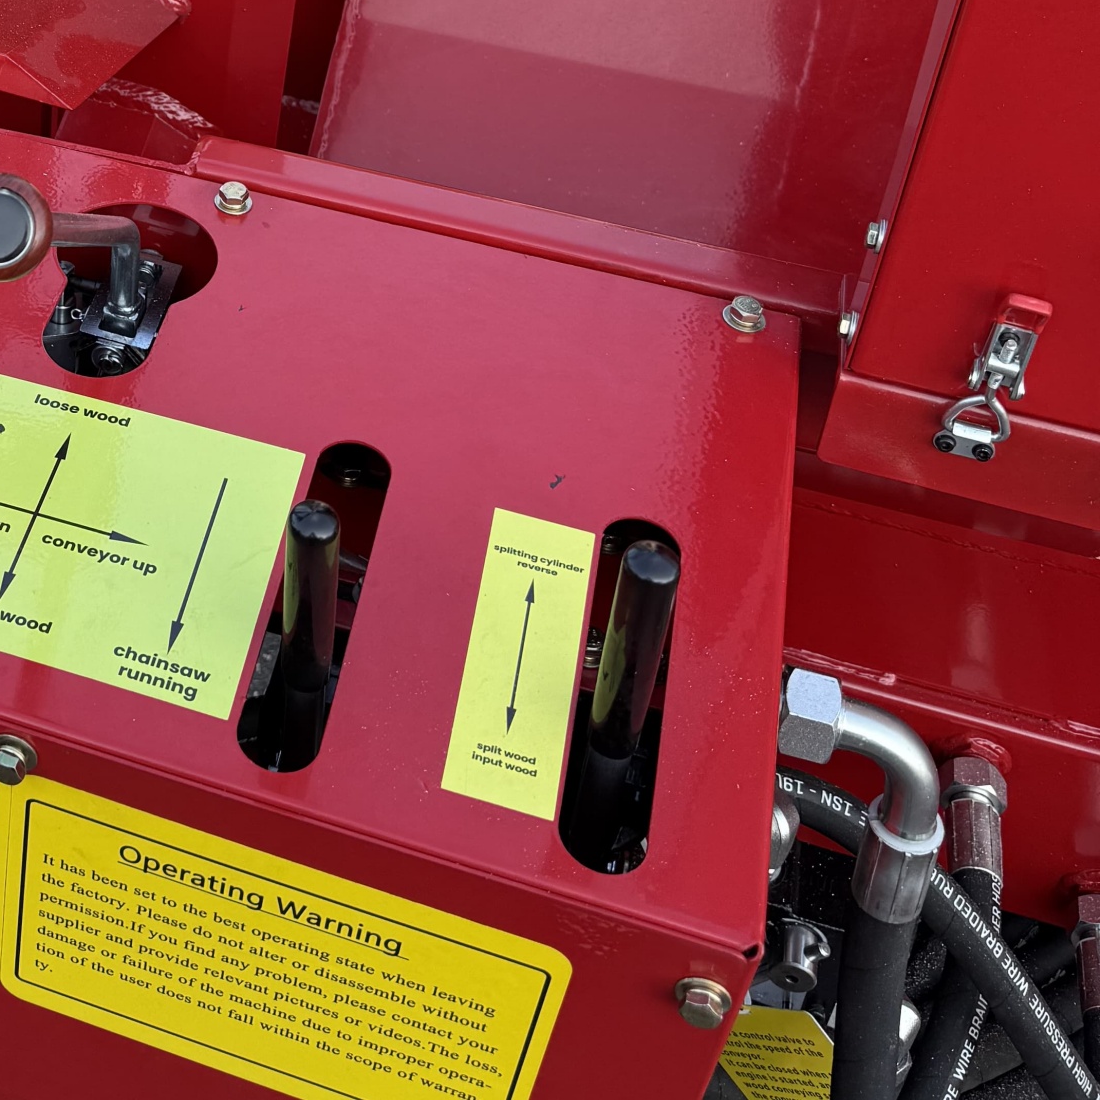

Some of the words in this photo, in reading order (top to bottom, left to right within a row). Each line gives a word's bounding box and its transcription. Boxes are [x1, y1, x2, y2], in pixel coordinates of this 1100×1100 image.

[34, 393, 80, 414] loose
[83, 408, 131, 427] wood
[41, 534, 130, 566] conveyor
[132, 559, 157, 576] up
[493, 544, 538, 563] splitting
[539, 557, 585, 574] cylinder
[517, 560, 558, 576] reverse
[0, 610, 53, 634] wood
[113, 646, 211, 683] chainsaw
[118, 666, 198, 702] running
[471, 750, 503, 768] input
[504, 762, 538, 778] wood
[476, 742, 502, 756] split
[504, 750, 537, 766] wood
[820, 790, 853, 817] 1SN
[118, 845, 264, 910] Operating
[276, 896, 402, 956] Warning
[43, 853, 55, 867] It
[60, 859, 86, 877] has
[91, 869, 128, 892] been
[133, 887, 156, 902] set
[161, 896, 177, 908] to
[183, 903, 207, 919] the
[213, 911, 246, 932] best
[251, 928, 331, 963] operating
[335, 956, 375, 975] state
[381, 971, 426, 993] when
[431, 985, 496, 1018] leaving
[954, 894, 1004, 958] BRAIDED
[35, 959, 53, 973] ty.
[41, 873, 65, 888] the
[70, 882, 130, 912] factory.
[136, 904, 187, 931] Please
[192, 925, 213, 939] do
[217, 935, 244, 950] not
[249, 946, 287, 964] alter
[291, 961, 310, 972] or
[314, 967, 416, 1008] disassemble
[422, 1004, 487, 1033] without
[1001, 951, 1029, 996] WIRE
[38, 909, 101, 937] supplier
[105, 933, 133, 949] and
[138, 944, 199, 971] provide
[203, 967, 268, 996] relevant
[273, 991, 339, 1019] pictures
[344, 1016, 363, 1027] or
[465, 1054, 502, 1078] loss,
[148, 929, 178, 946] you
[183, 940, 216, 959] find
[220, 955, 250, 972] any
[254, 966, 328, 999] problem,
[332, 993, 386, 1017] please
[391, 1013, 452, 1040] contact
[456, 1035, 498, 1055] your
[739, 1032, 774, 1041] control
[775, 1035, 802, 1045] valve
[802, 1038, 815, 1046] to
[1029, 993, 1075, 1068] PRESSURE
[744, 1042, 762, 1051] the
[763, 1044, 793, 1054] speed
[793, 1047, 805, 1055] of
[805, 1048, 824, 1058] the
[952, 1038, 975, 1081] WIRE
[735, 1071, 768, 1081] engine
[767, 1073, 778, 1082] is
[736, 1061, 753, 1069] can
[754, 1062, 766, 1070] be
[768, 1064, 799, 1075] closed
[800, 1069, 829, 1079] when
[1072, 1062, 1093, 1098] HIGH
